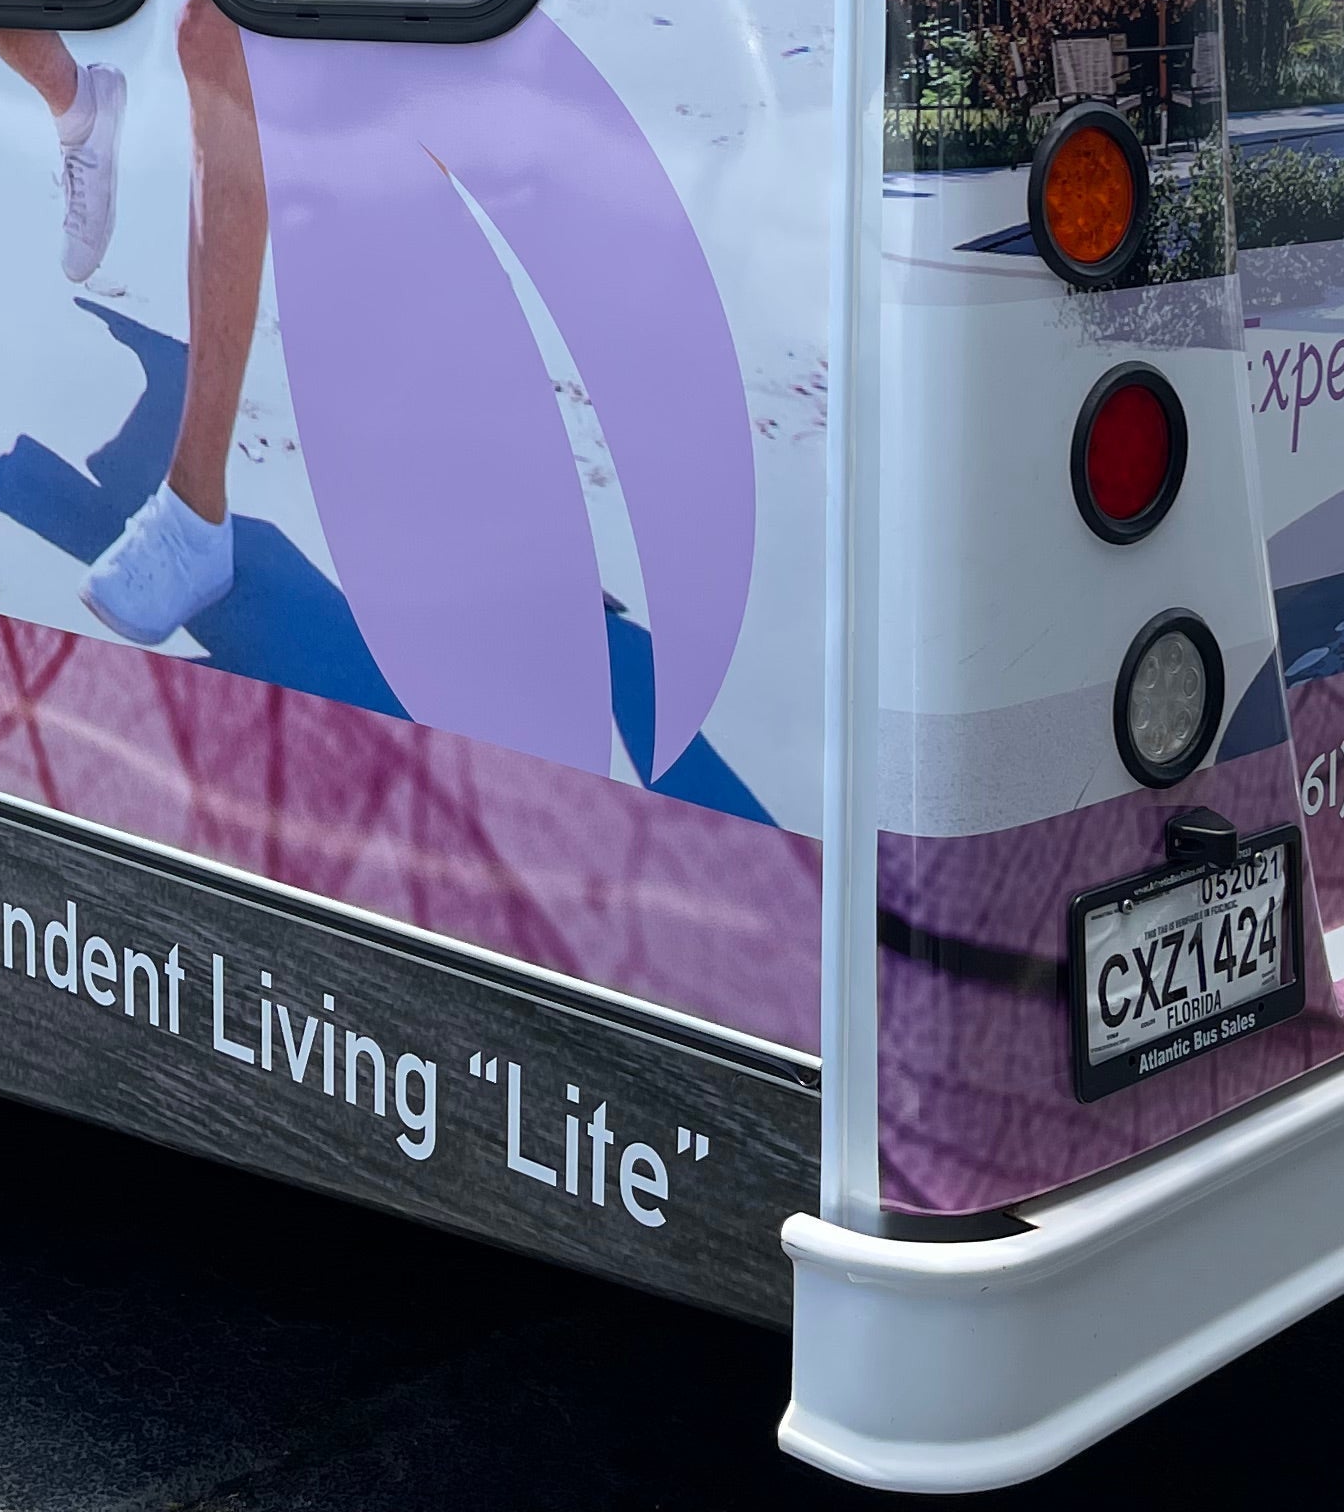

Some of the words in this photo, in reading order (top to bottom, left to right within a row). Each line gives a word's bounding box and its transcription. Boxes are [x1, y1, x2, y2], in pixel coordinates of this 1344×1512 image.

[1201, 850, 1280, 904] 052021
[1098, 896, 1276, 1028] CXZ1424
[1167, 990, 1222, 1029] FLORIDA
[212, 953, 437, 1161] Living
[1139, 1038, 1190, 1074] Atlantic
[1193, 1028, 1218, 1050] Bus
[1221, 1013, 1256, 1038] Sales
